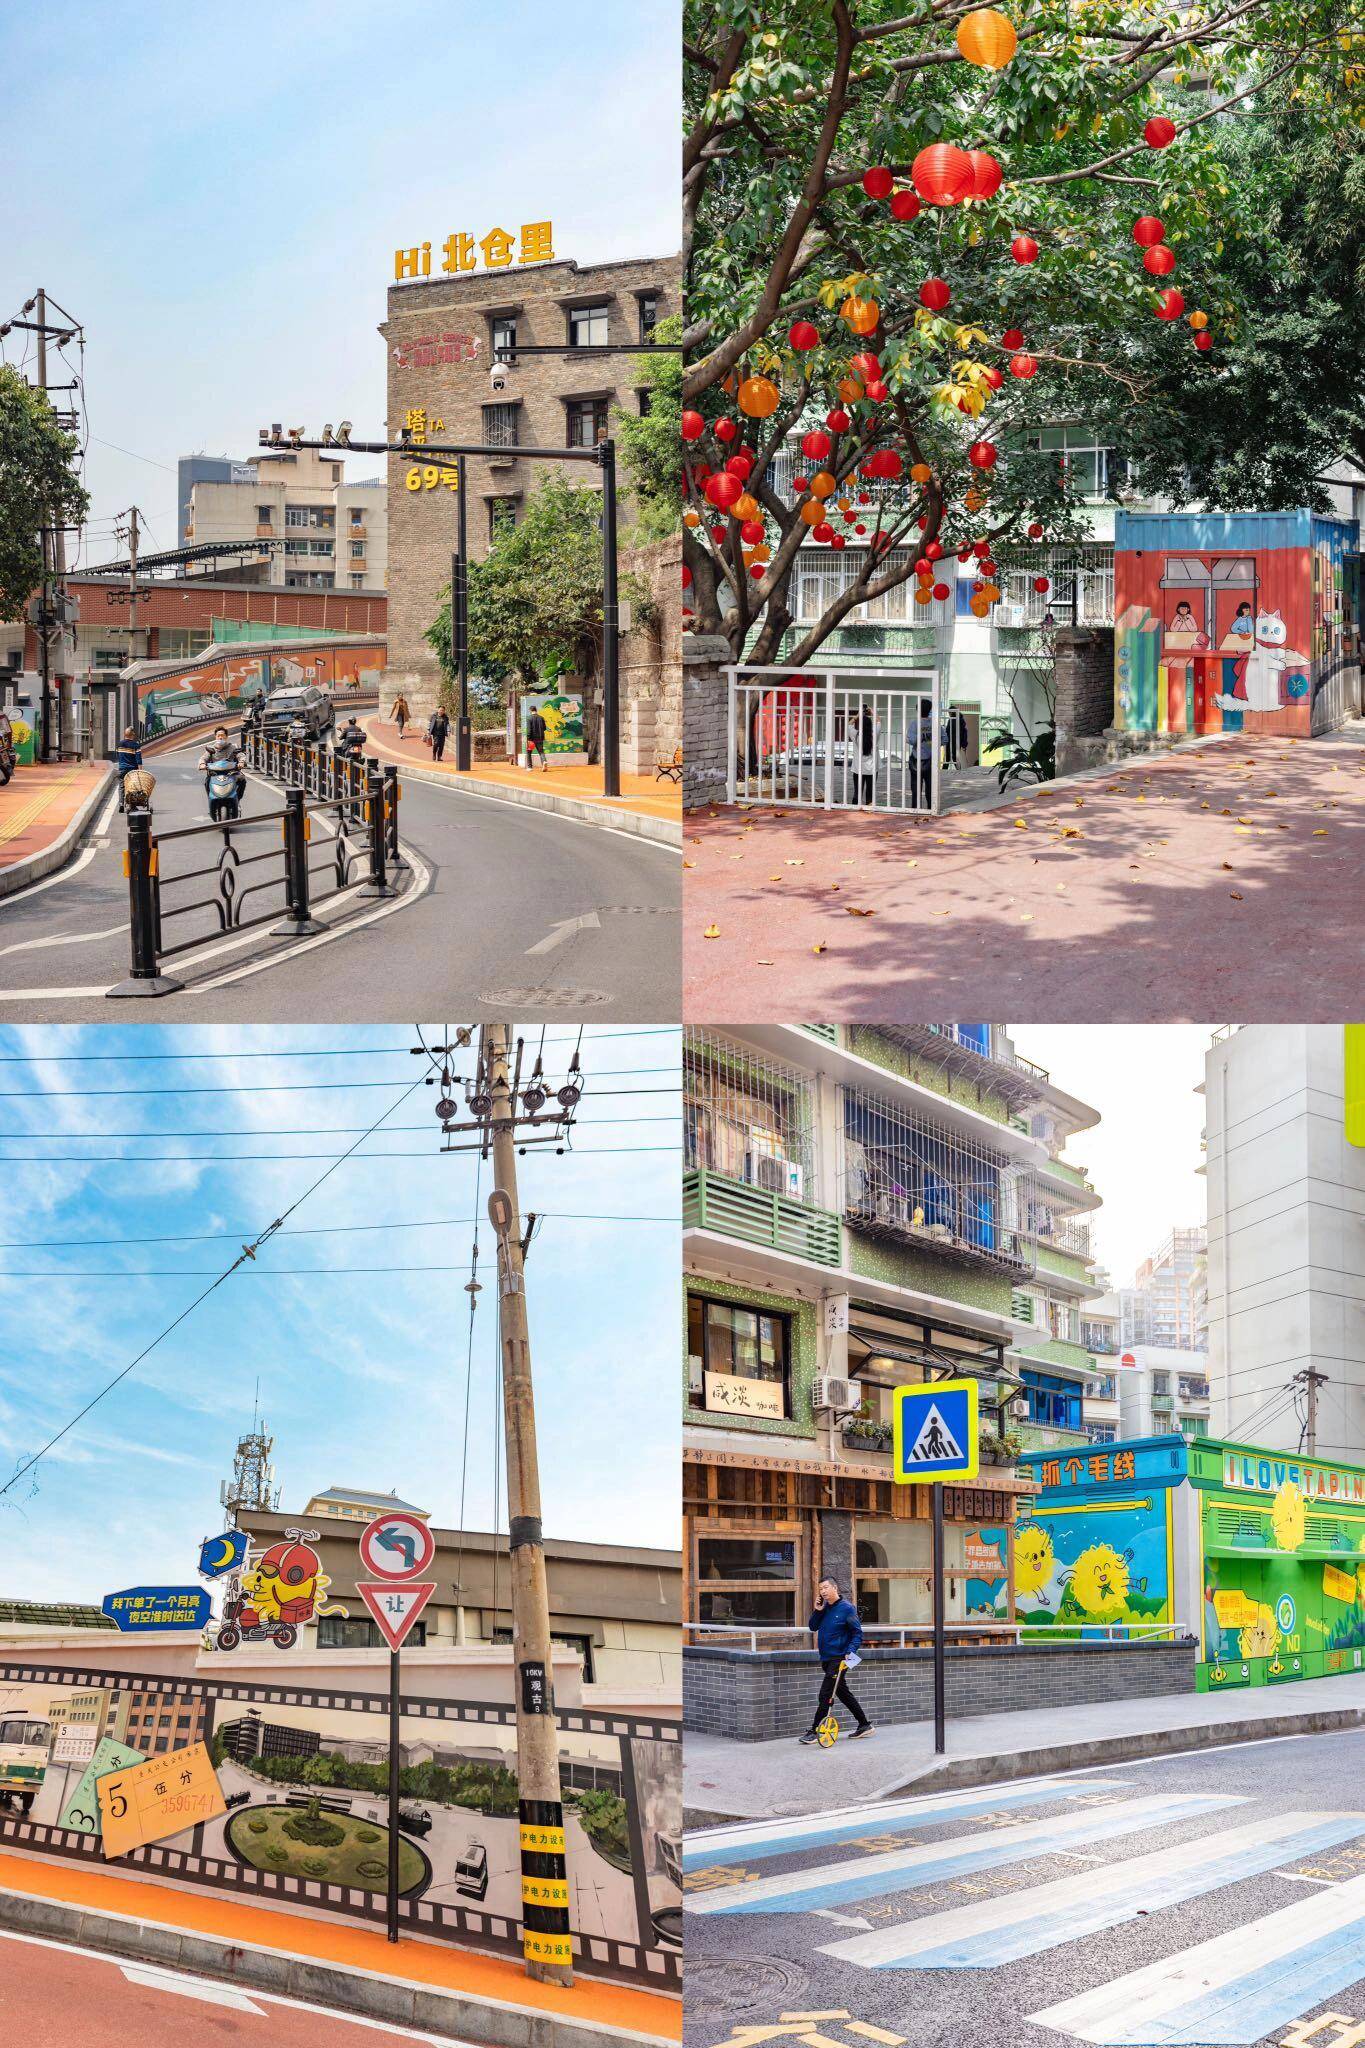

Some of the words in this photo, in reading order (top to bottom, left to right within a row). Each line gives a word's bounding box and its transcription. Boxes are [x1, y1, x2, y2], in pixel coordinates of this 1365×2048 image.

[394, 242, 431, 280] Hi
[441, 221, 555, 273] 北仓里
[405, 408, 427, 433] 塔
[429, 419, 446, 432] TA
[712, 1381, 751, 1408] 咸淡
[756, 1401, 780, 1413] 咖啡
[1041, 1450, 1135, 1487] 抓个毛线
[1229, 1456, 1235, 1482] I
[1243, 1459, 1299, 1489] LOVE
[1303, 1469, 1363, 1500] TAPIN
[111, 1595, 201, 1609] 我下单了一个月亮
[385, 1595, 405, 1614] 让
[129, 1609, 196, 1624] 夜空准时送达
[1286, 1634, 1300, 1652] NO
[61, 1726, 67, 1736] 5
[109, 1782, 127, 1818] 5
[161, 1793, 214, 1815] 3596741
[69, 1808, 95, 1834] 3
